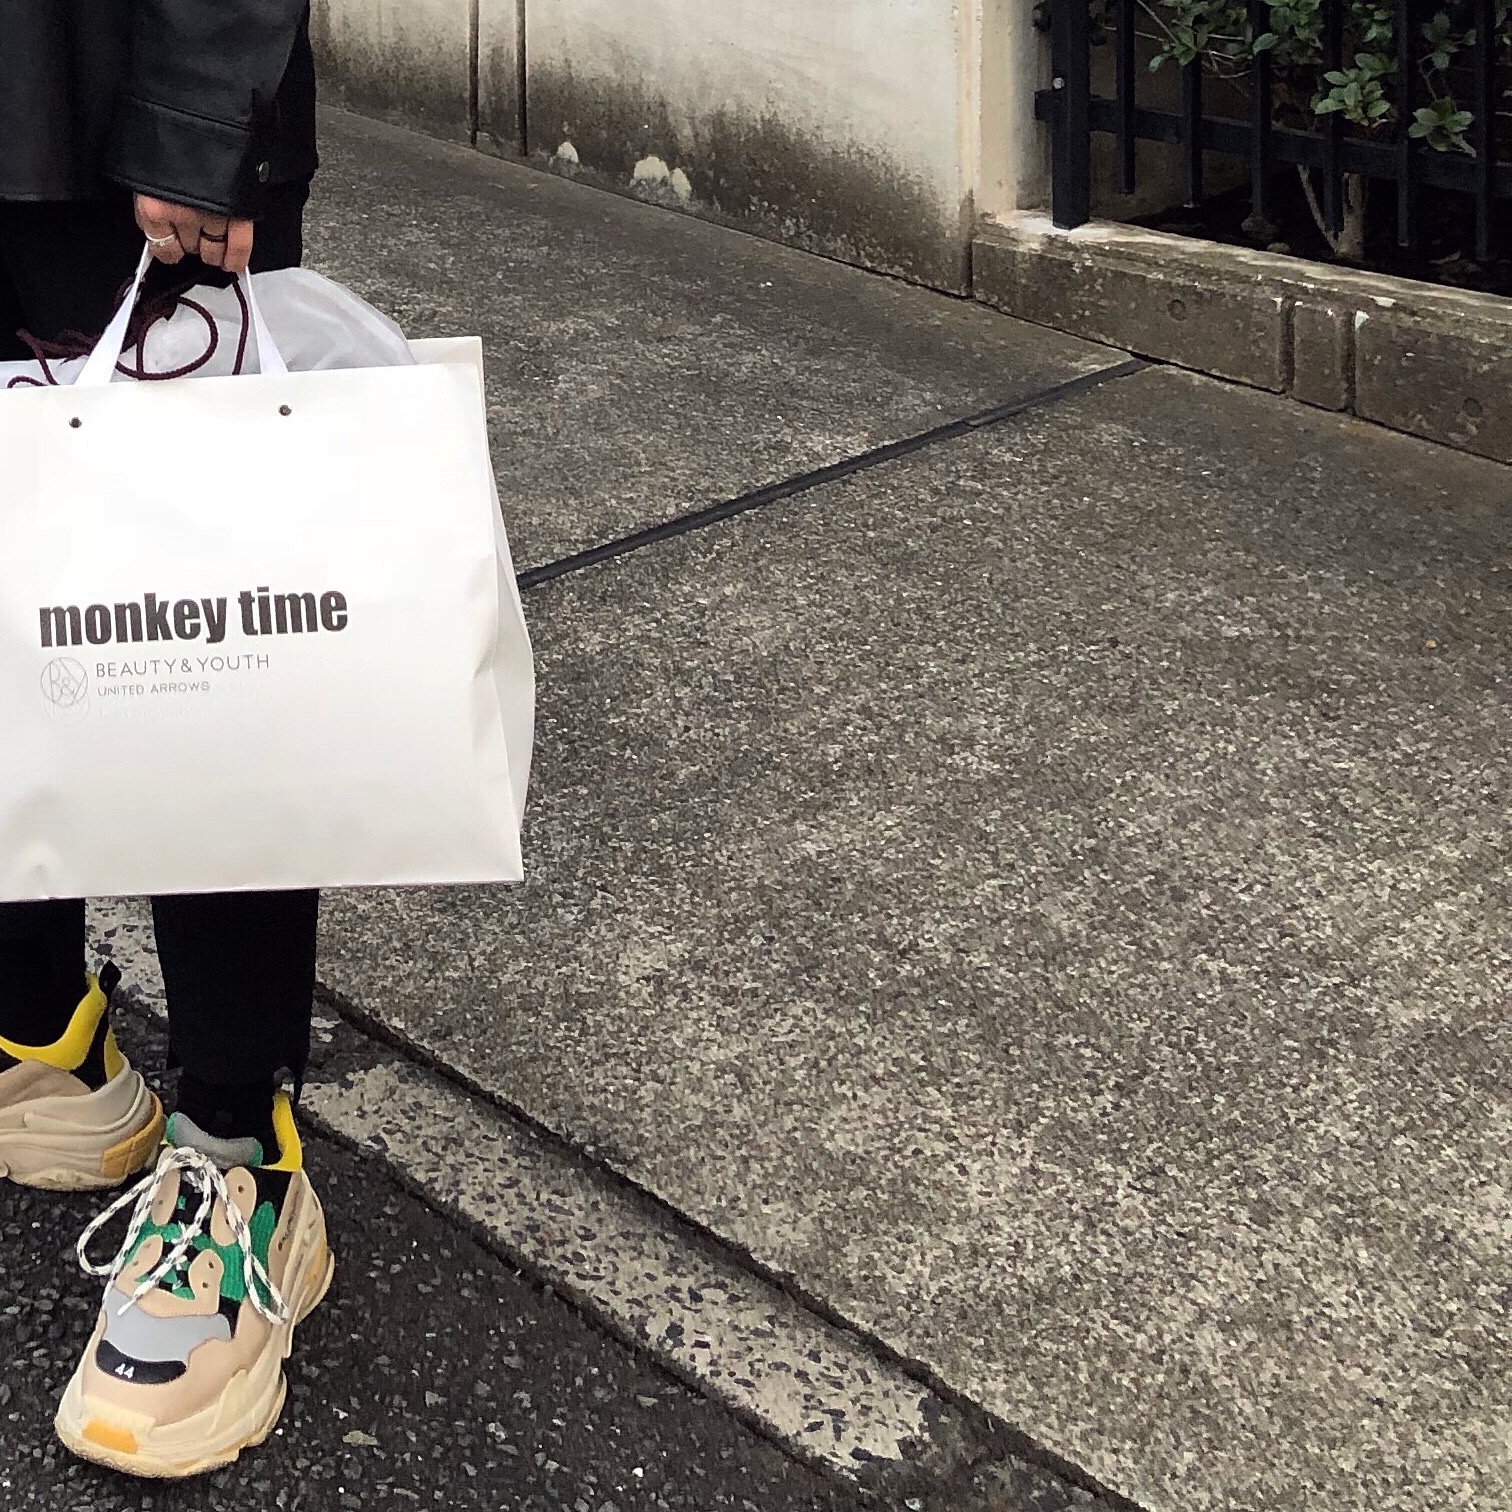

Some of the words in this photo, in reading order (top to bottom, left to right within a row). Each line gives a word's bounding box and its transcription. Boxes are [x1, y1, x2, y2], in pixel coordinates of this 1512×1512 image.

[39, 592, 227, 647] monkey
[238, 586, 348, 636] time
[97, 684, 145, 697] UNITED
[150, 680, 210, 694] ARROWS
[114, 1363, 135, 1379] 44
